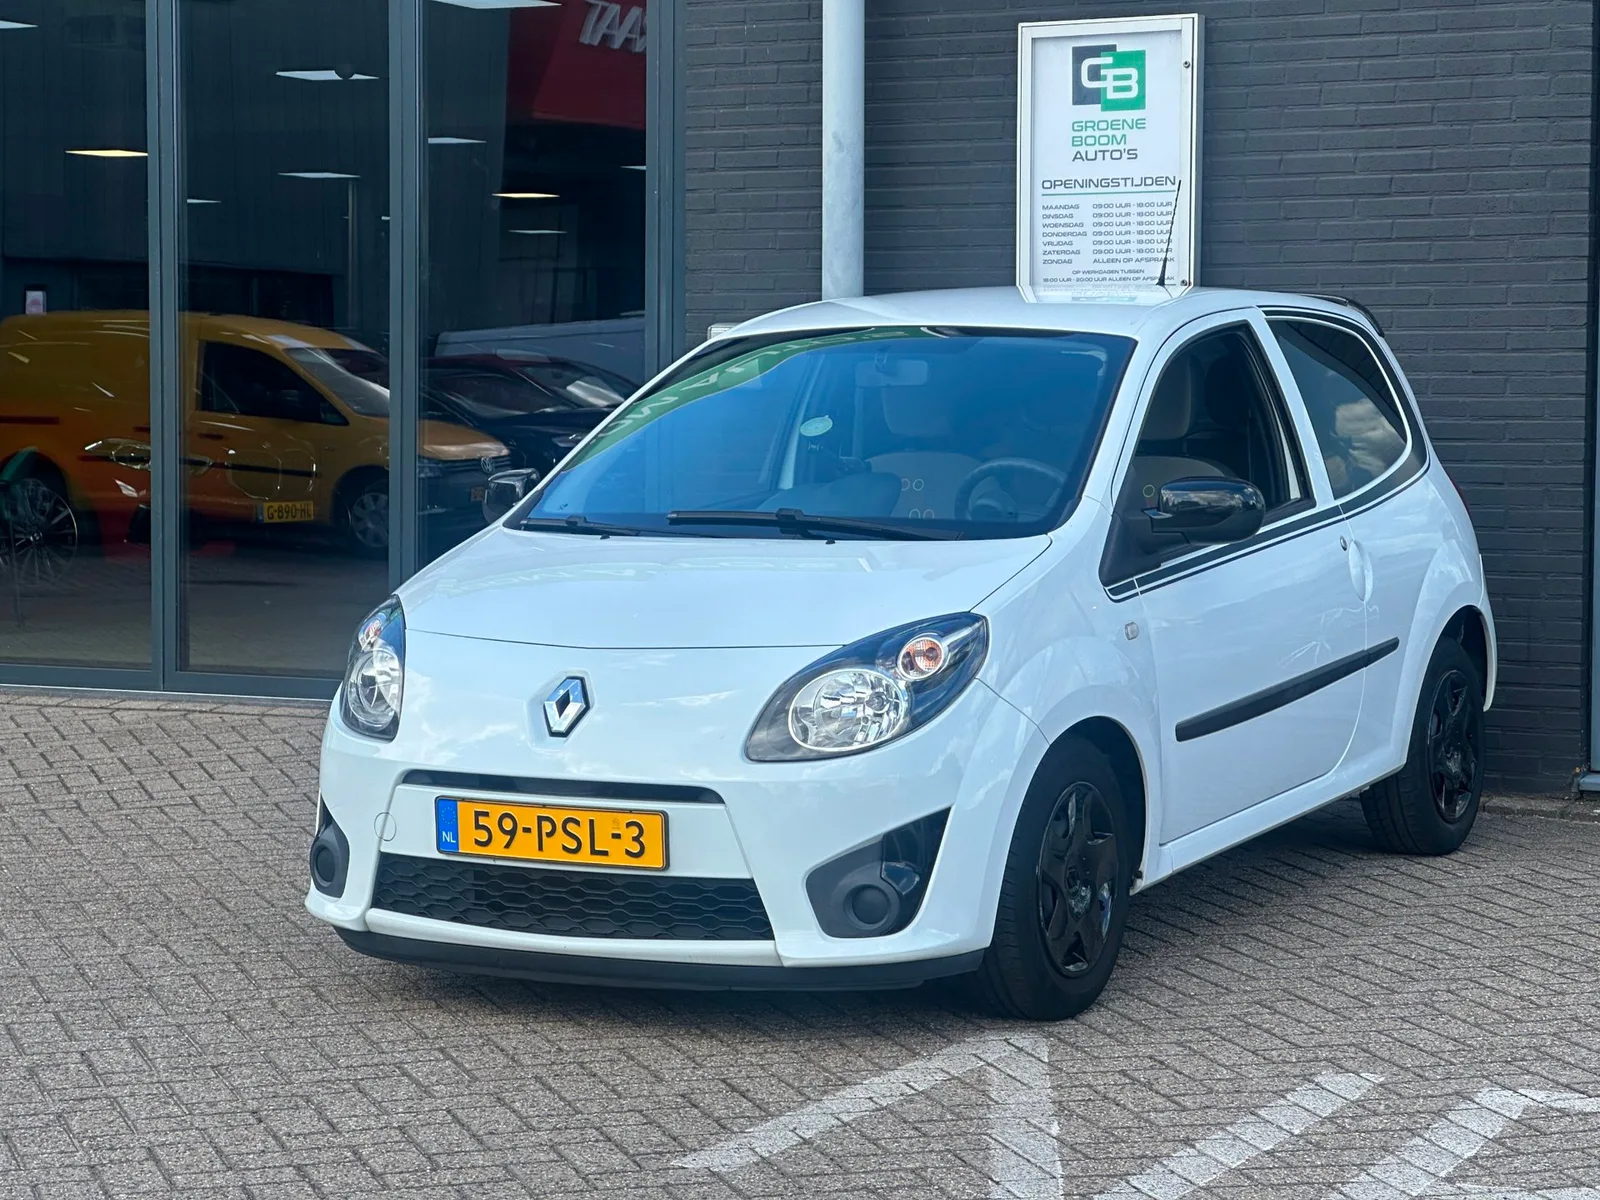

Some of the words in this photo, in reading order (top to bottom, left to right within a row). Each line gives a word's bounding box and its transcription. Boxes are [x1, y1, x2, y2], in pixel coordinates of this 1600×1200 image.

[579, 0, 647, 53] TAA
[1072, 118, 1146, 132] GROENE
[1072, 134, 1127, 147] BOOM
[1072, 148, 1138, 162] AUTO'S
[1042, 175, 1176, 190] OPENINGSTIJDEN
[267, 503, 312, 520] G-890-HL
[442, 830, 457, 843] NL
[473, 810, 646, 859] 59-PSL-3
